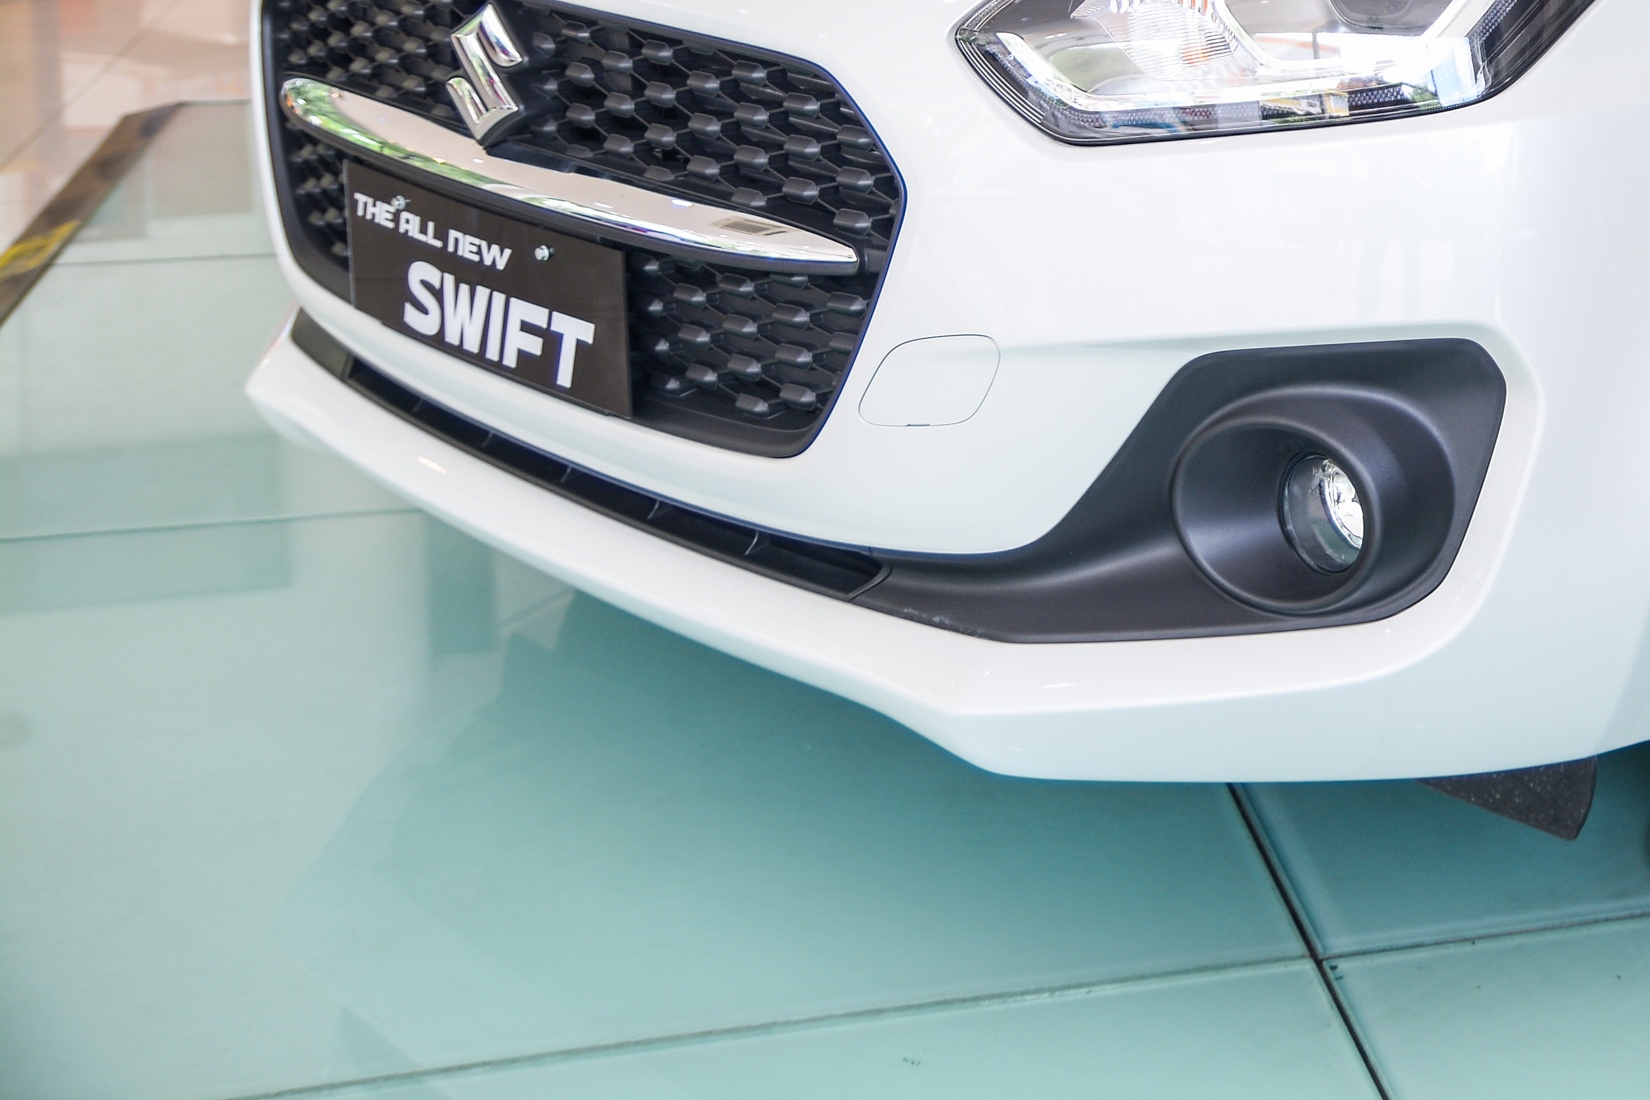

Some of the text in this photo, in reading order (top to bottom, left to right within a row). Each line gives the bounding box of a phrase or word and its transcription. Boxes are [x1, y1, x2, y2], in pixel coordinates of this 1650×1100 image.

[354, 192, 395, 229] THE
[398, 210, 443, 248] ALL
[403, 260, 595, 389] SWIFT
